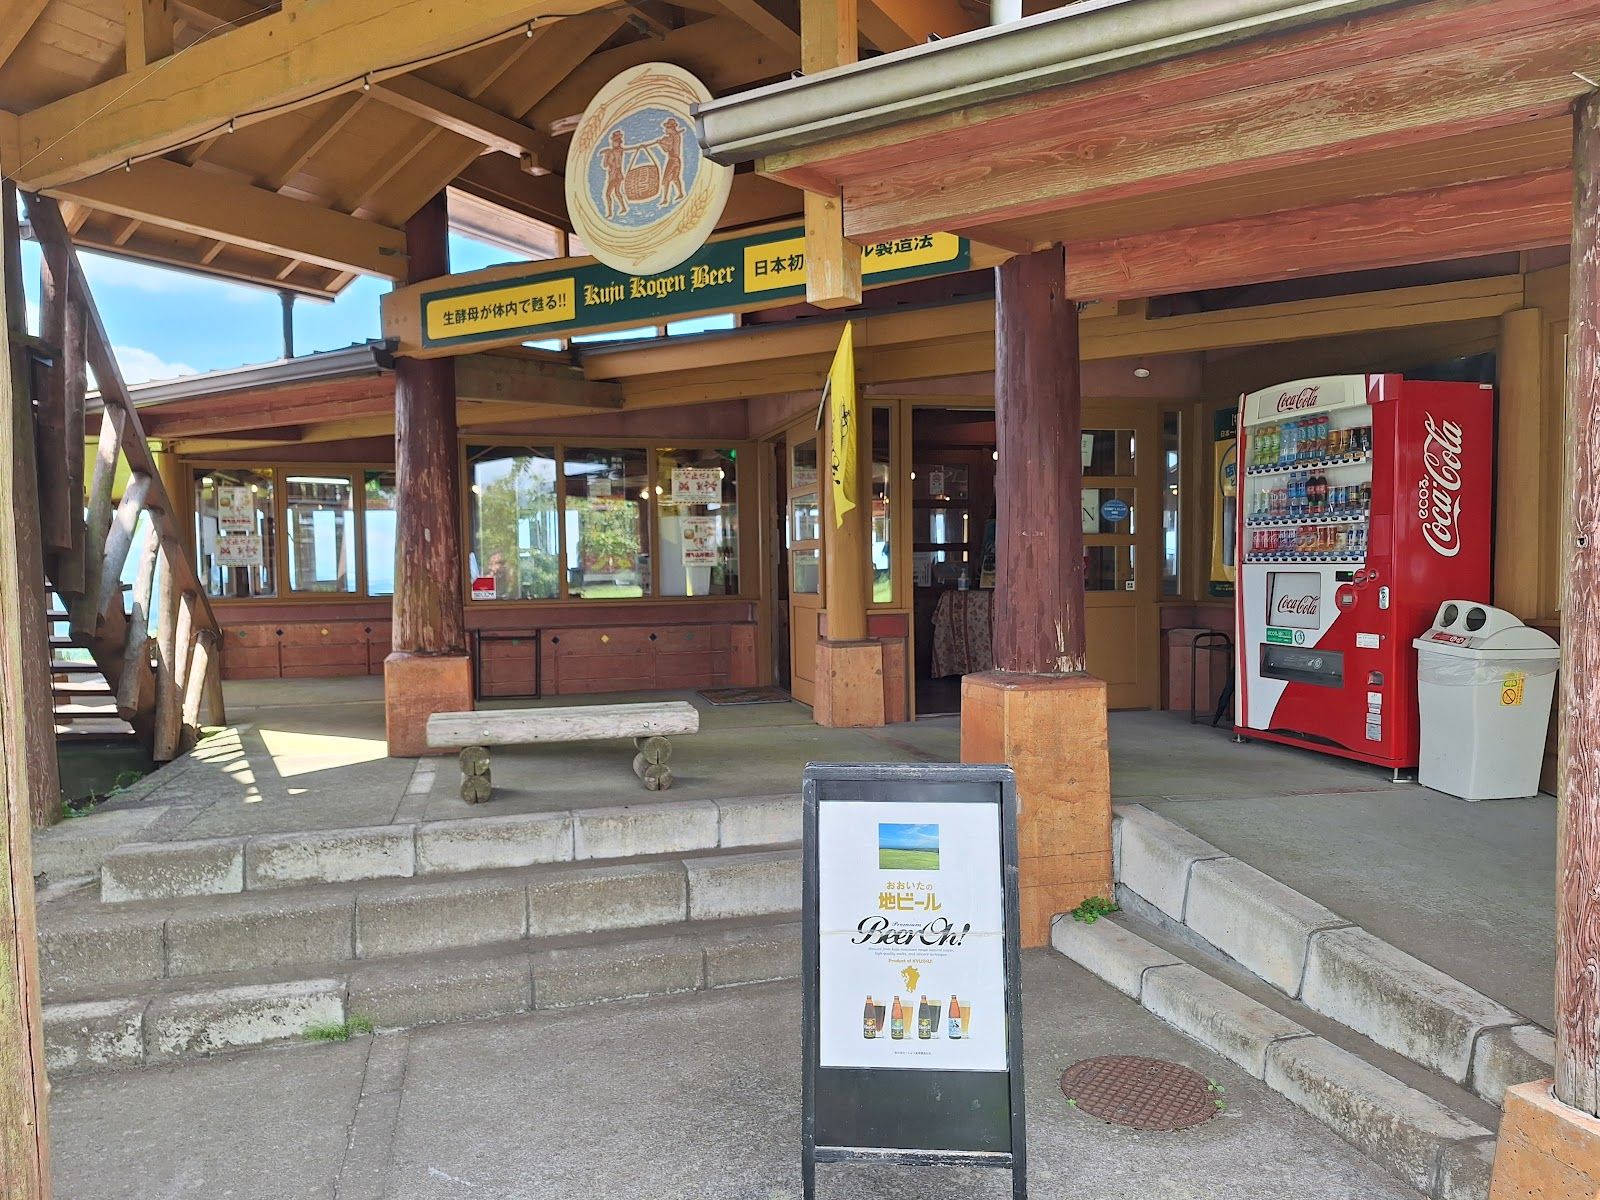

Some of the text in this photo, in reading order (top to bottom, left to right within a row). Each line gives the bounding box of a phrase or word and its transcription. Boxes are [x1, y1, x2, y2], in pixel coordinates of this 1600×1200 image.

[583, 264, 735, 306] Kuju Kogen Beer
[1277, 386, 1320, 412] Coca-Cola
[1422, 411, 1462, 557] Coca-Cola
[1277, 594, 1320, 615] Coca-Cola
[886, 880, 933, 891] おおいたの
[878, 892, 942, 911] 地ビール
